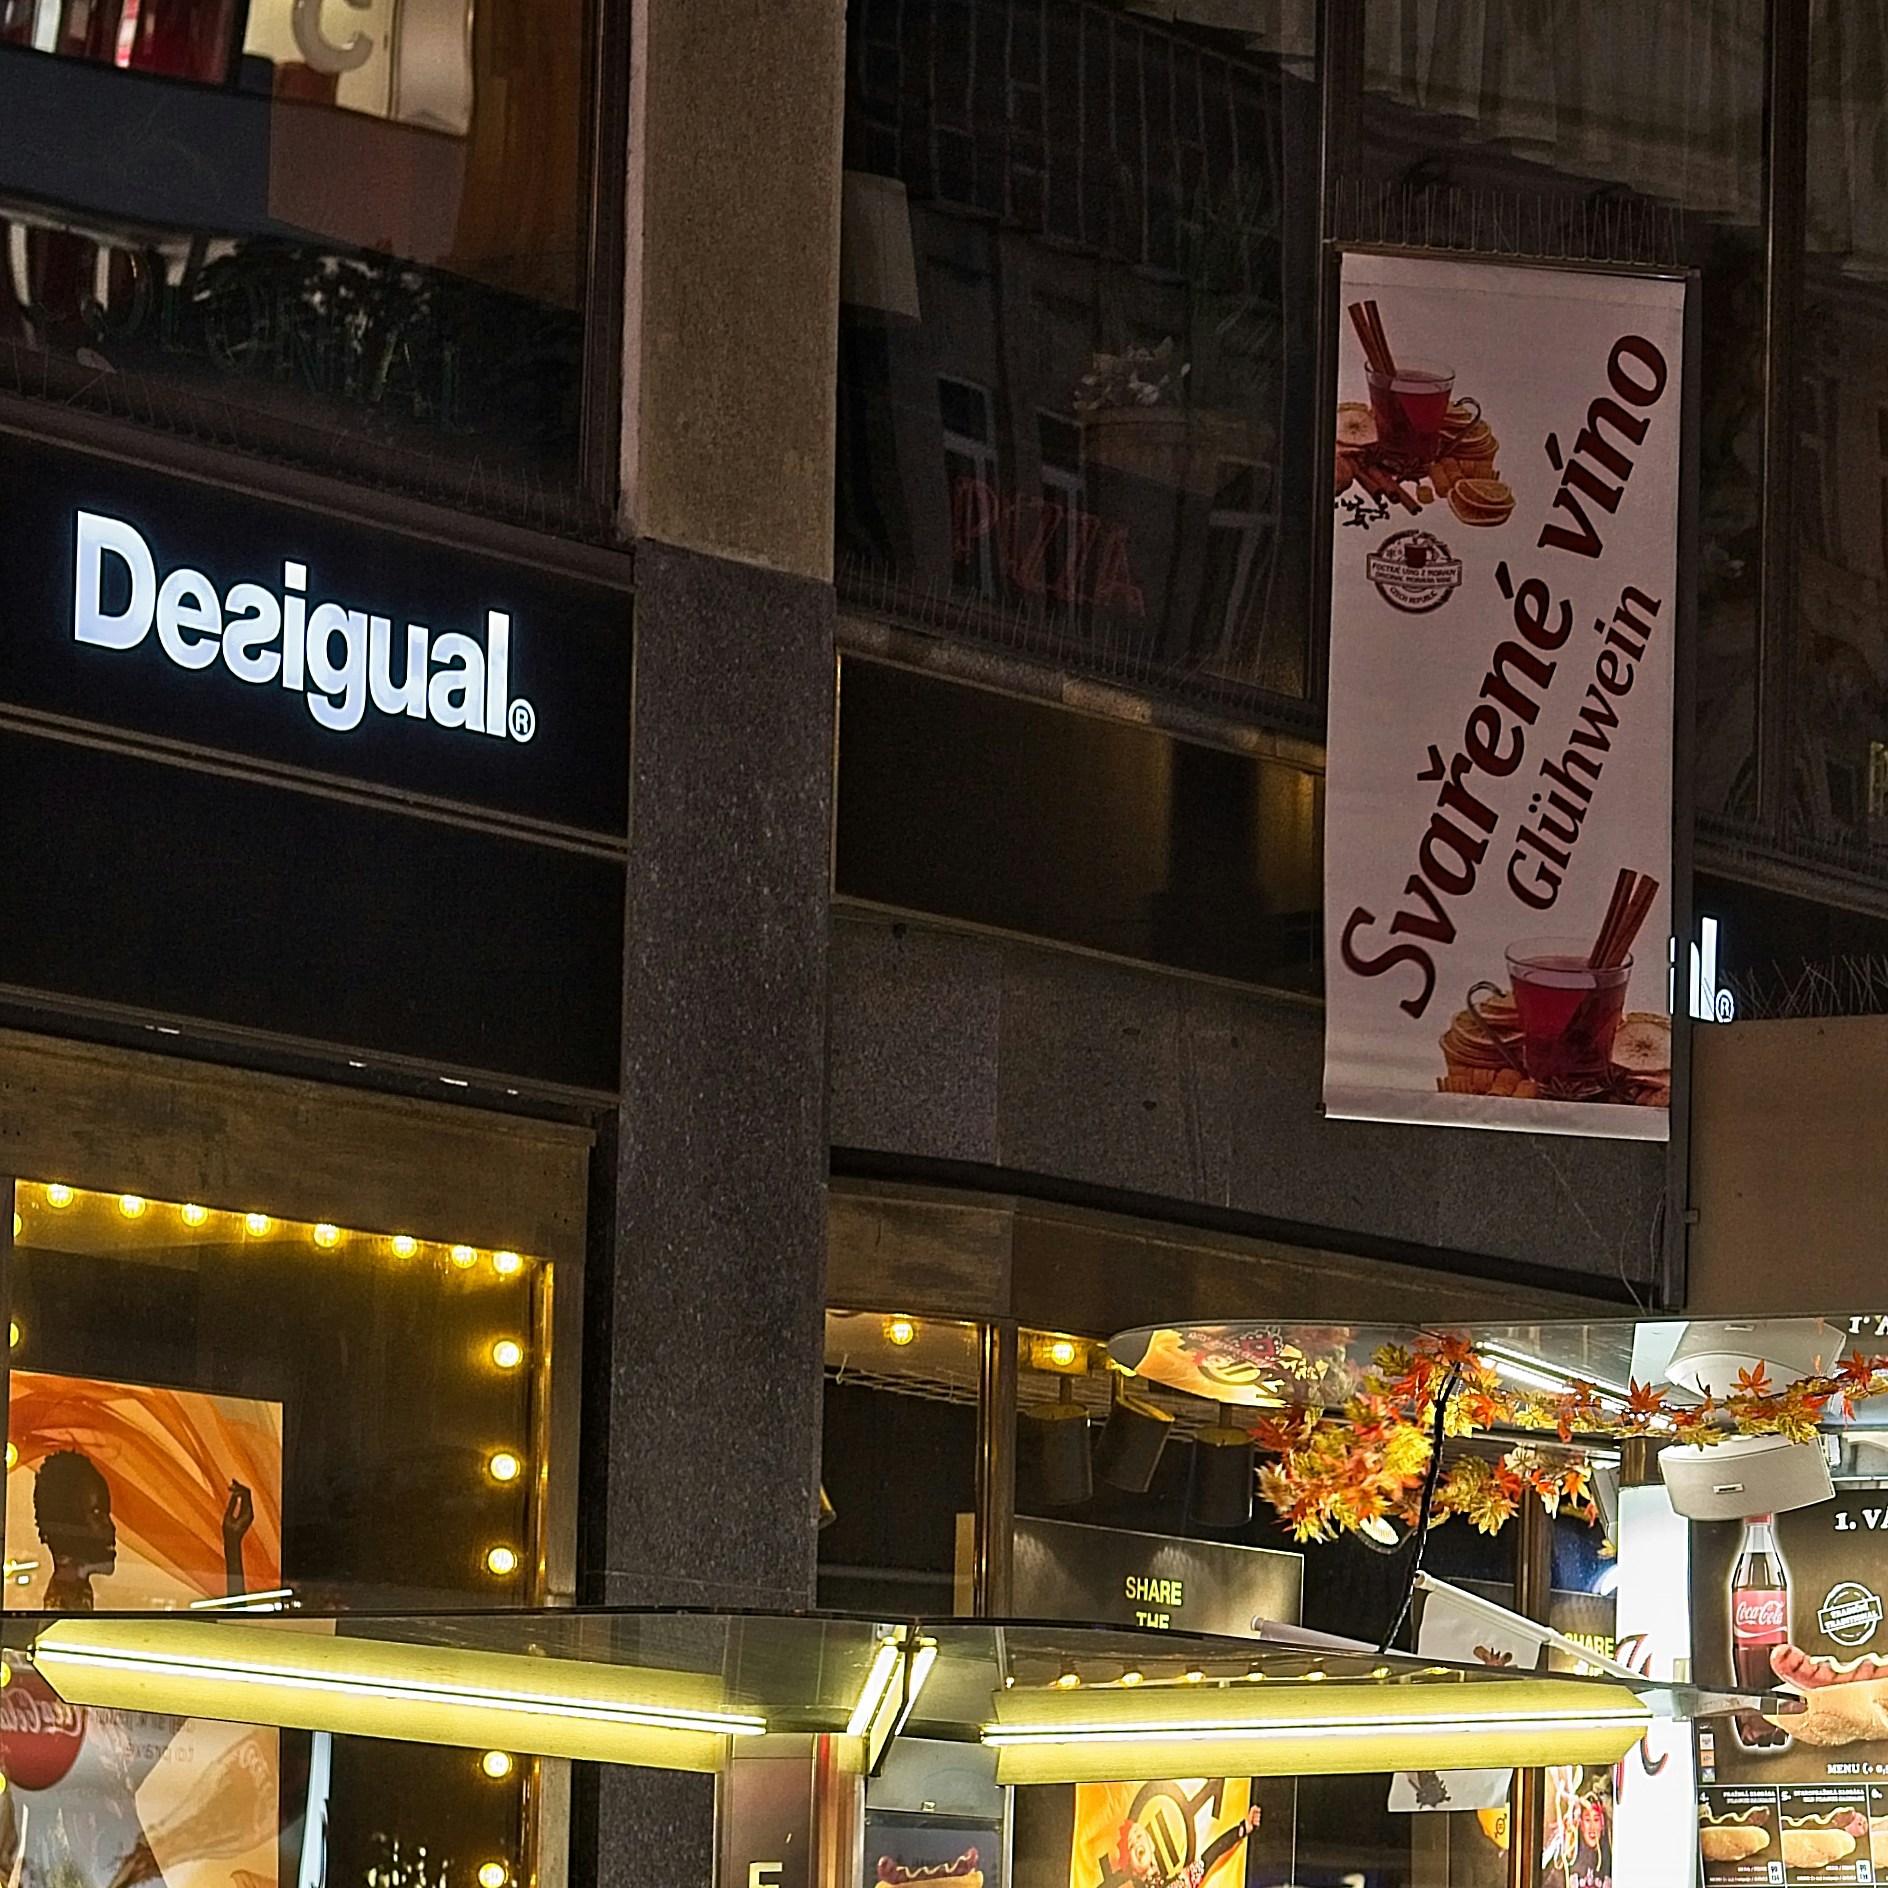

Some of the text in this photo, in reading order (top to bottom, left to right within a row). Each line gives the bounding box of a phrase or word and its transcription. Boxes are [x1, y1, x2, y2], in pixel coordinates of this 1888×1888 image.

[74, 511, 508, 737] Desigual
[1340, 561, 1574, 1018] Svařené
[1537, 334, 1669, 560] víno
[1505, 583, 1663, 911] Glühwein
[1125, 1576, 1182, 1605] SHARE
[1136, 1611, 1169, 1629] THE
[1736, 1600, 1785, 1626] Coca-Cola
[1827, 1763, 1860, 1775] MENU
